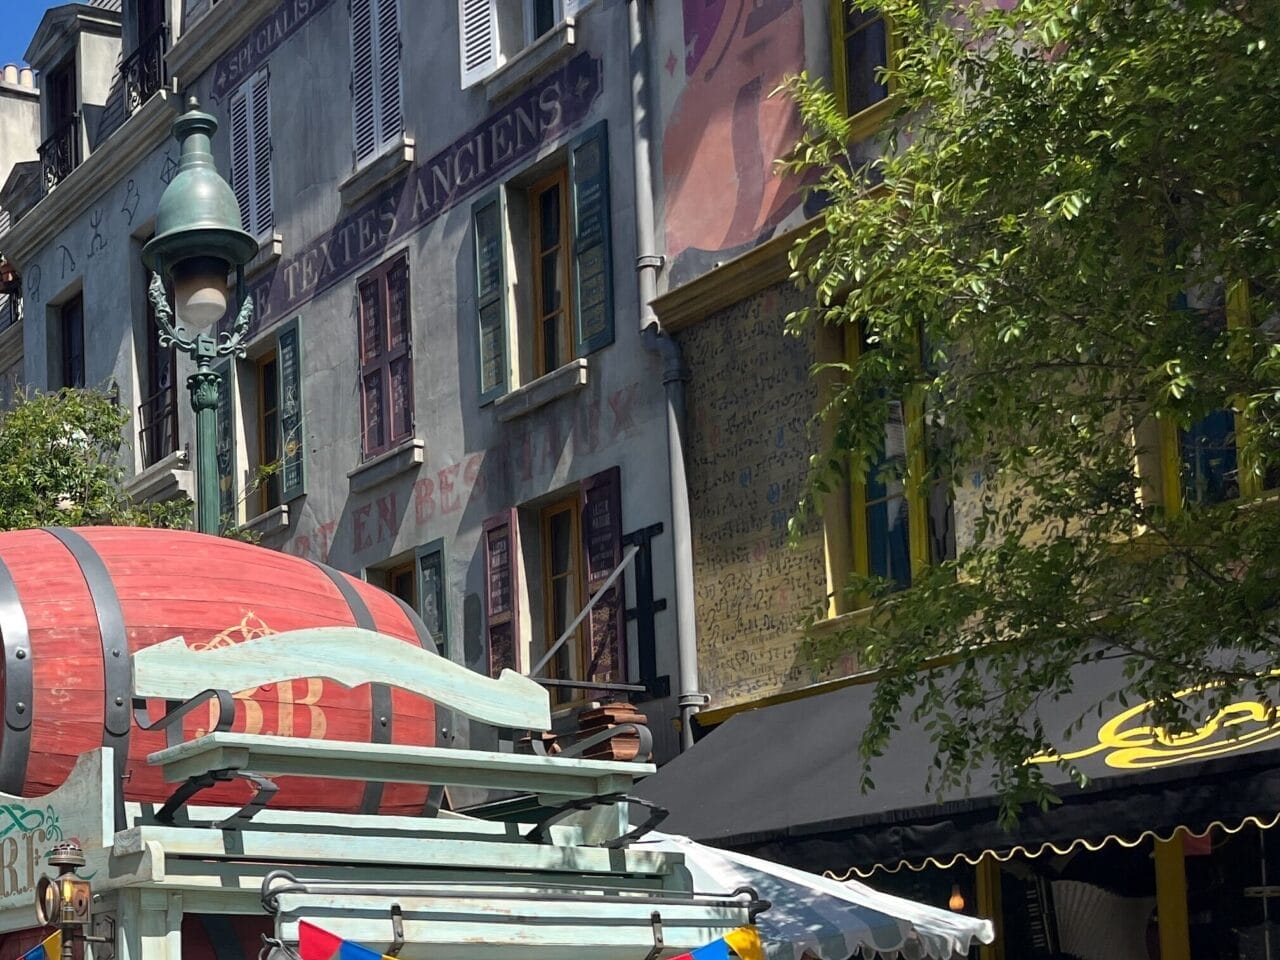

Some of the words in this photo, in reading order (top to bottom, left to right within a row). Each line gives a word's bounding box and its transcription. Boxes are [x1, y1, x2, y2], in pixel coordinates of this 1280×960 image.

[283, 198, 398, 301] TEXTES
[410, 84, 564, 222] ANCIENS
[351, 494, 399, 553] EN
